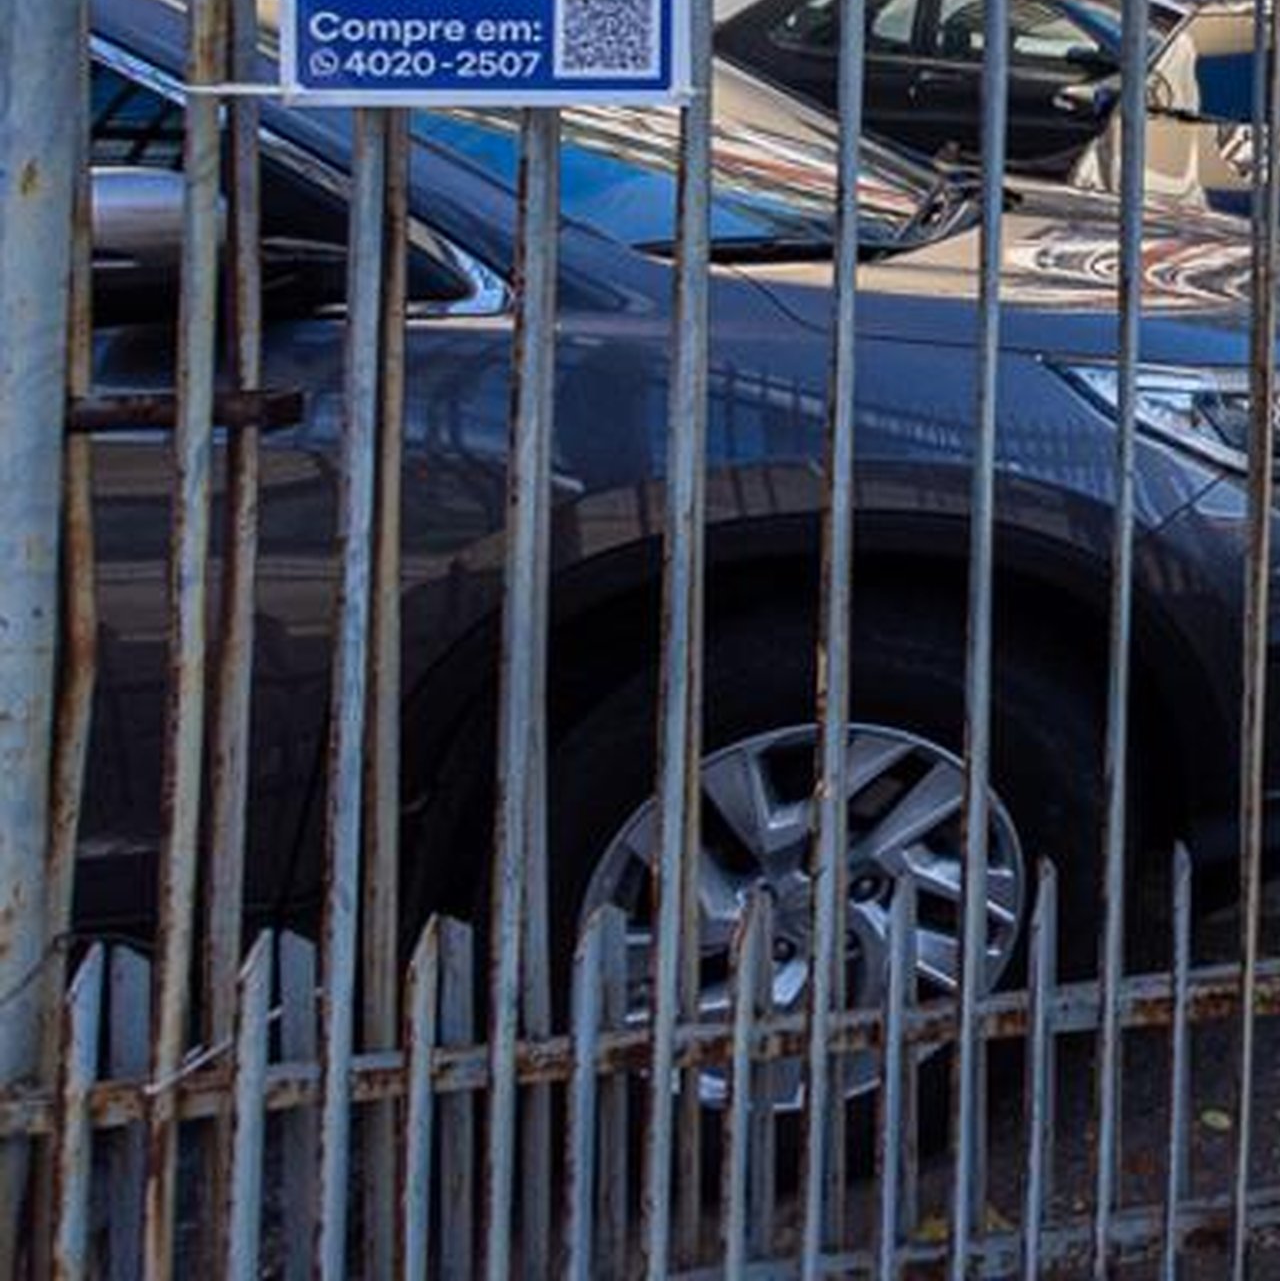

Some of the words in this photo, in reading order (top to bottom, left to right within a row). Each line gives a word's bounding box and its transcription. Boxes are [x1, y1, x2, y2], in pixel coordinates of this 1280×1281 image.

[309, 11, 466, 48] Compre
[475, 19, 542, 42] em:
[344, 50, 542, 78] 4020-2507
